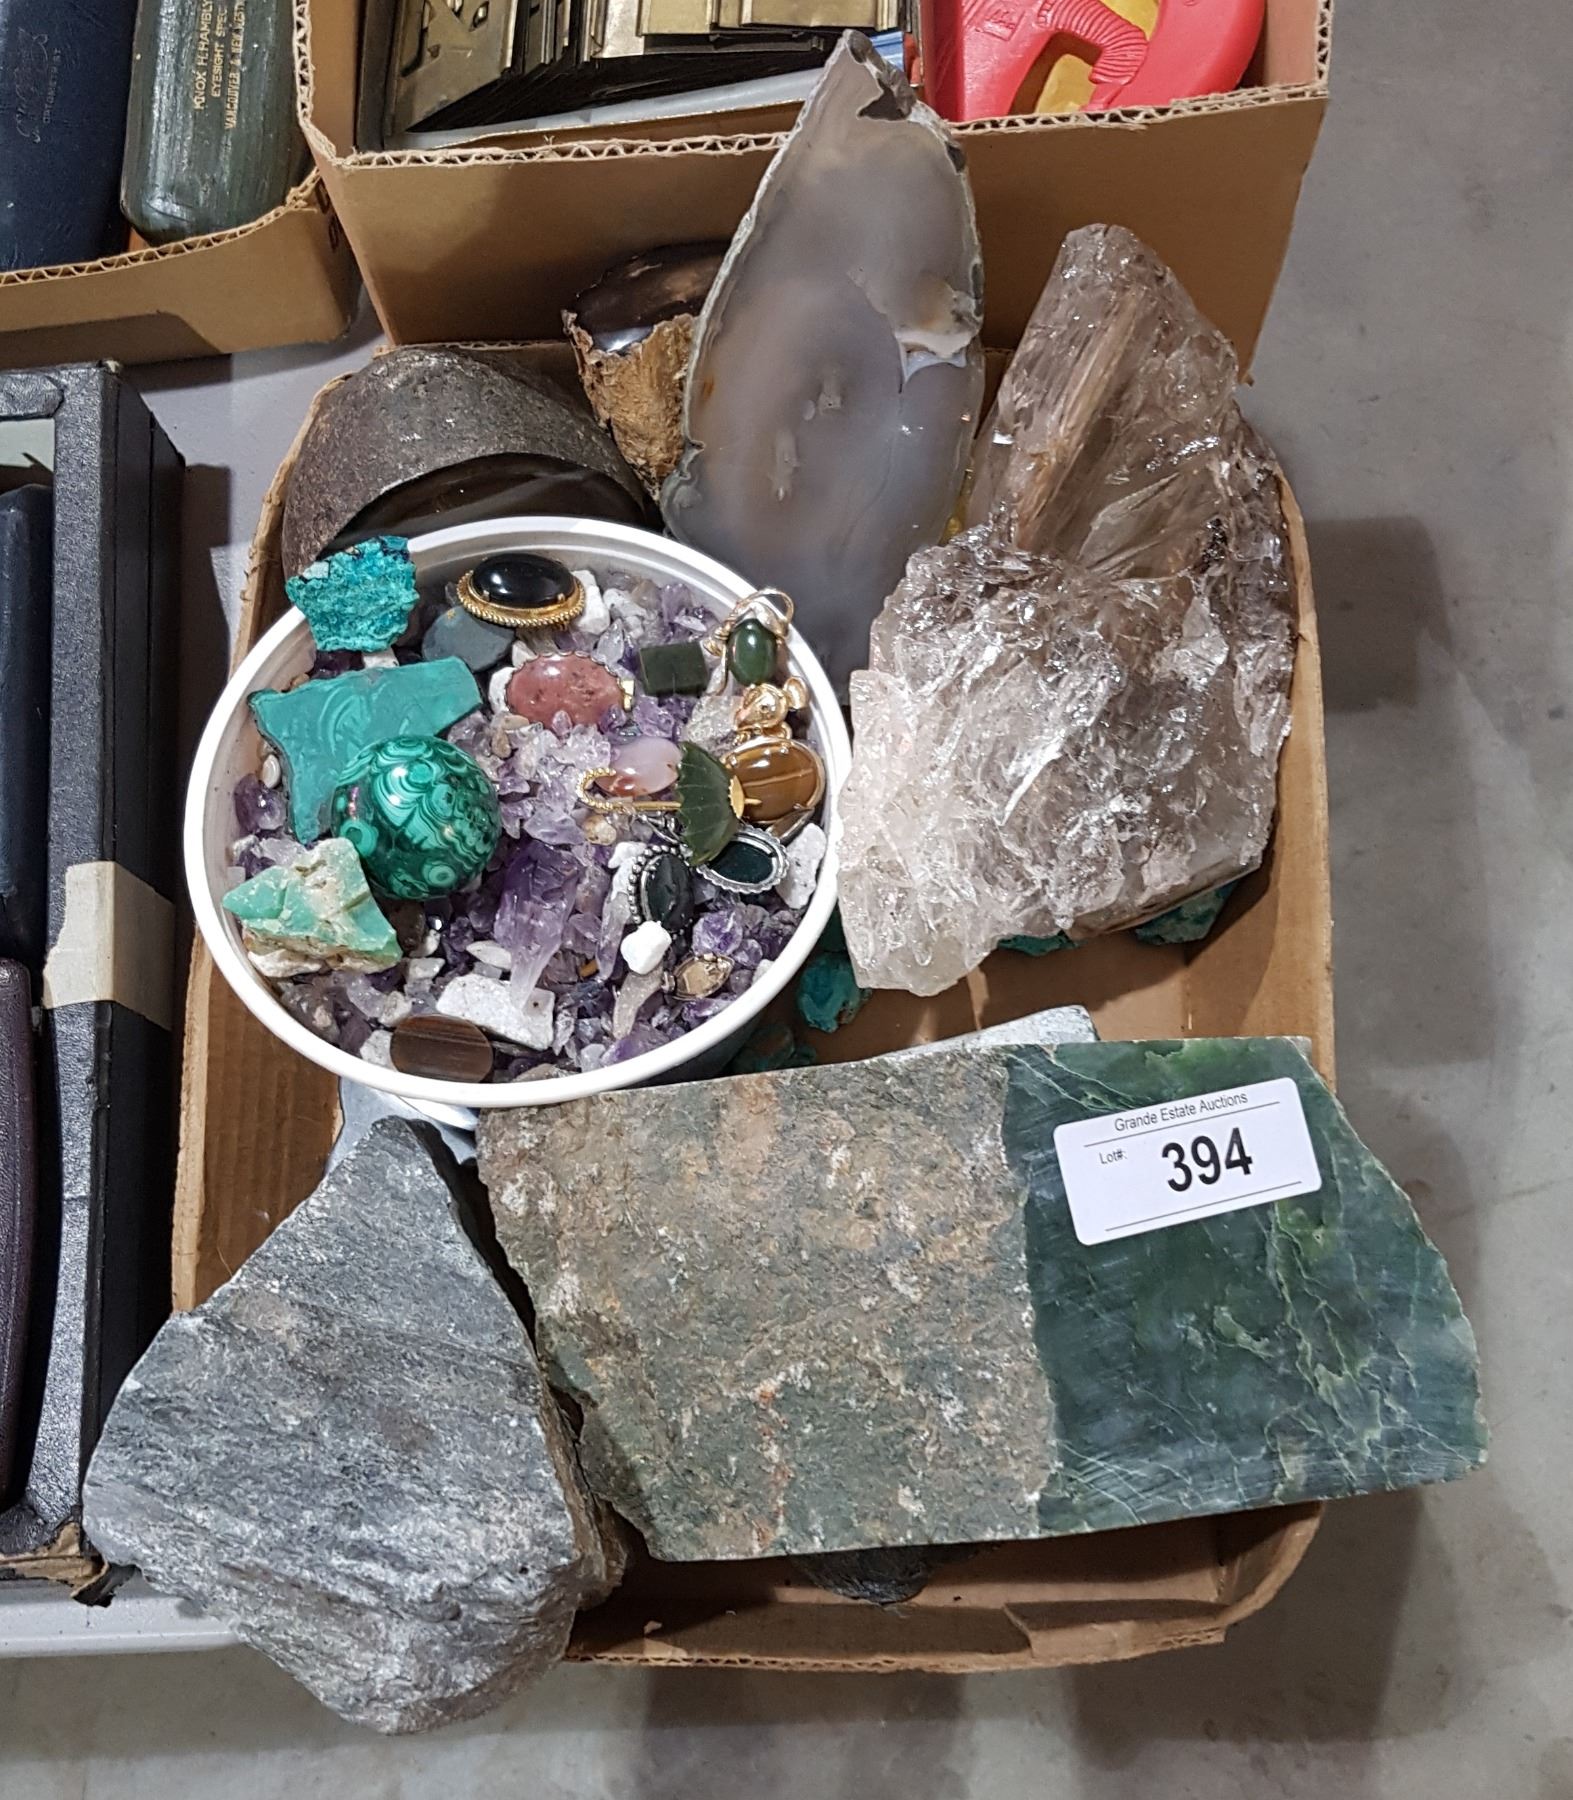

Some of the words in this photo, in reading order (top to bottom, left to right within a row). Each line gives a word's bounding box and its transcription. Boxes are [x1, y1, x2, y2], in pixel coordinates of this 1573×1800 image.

[211, 41, 225, 97] EYESIGHT
[231, 32, 243, 53] NEW
[43, 48, 60, 124] OPTOMETRST
[193, 71, 207, 110] KNOX
[224, 72, 240, 129] VANCOUVER
[1114, 1112, 1158, 1132] Grande
[1161, 1105, 1196, 1121] Estate
[1199, 1092, 1248, 1113] Auctions
[1099, 1149, 1128, 1164] Lot#:
[1161, 1127, 1253, 1192] 394
